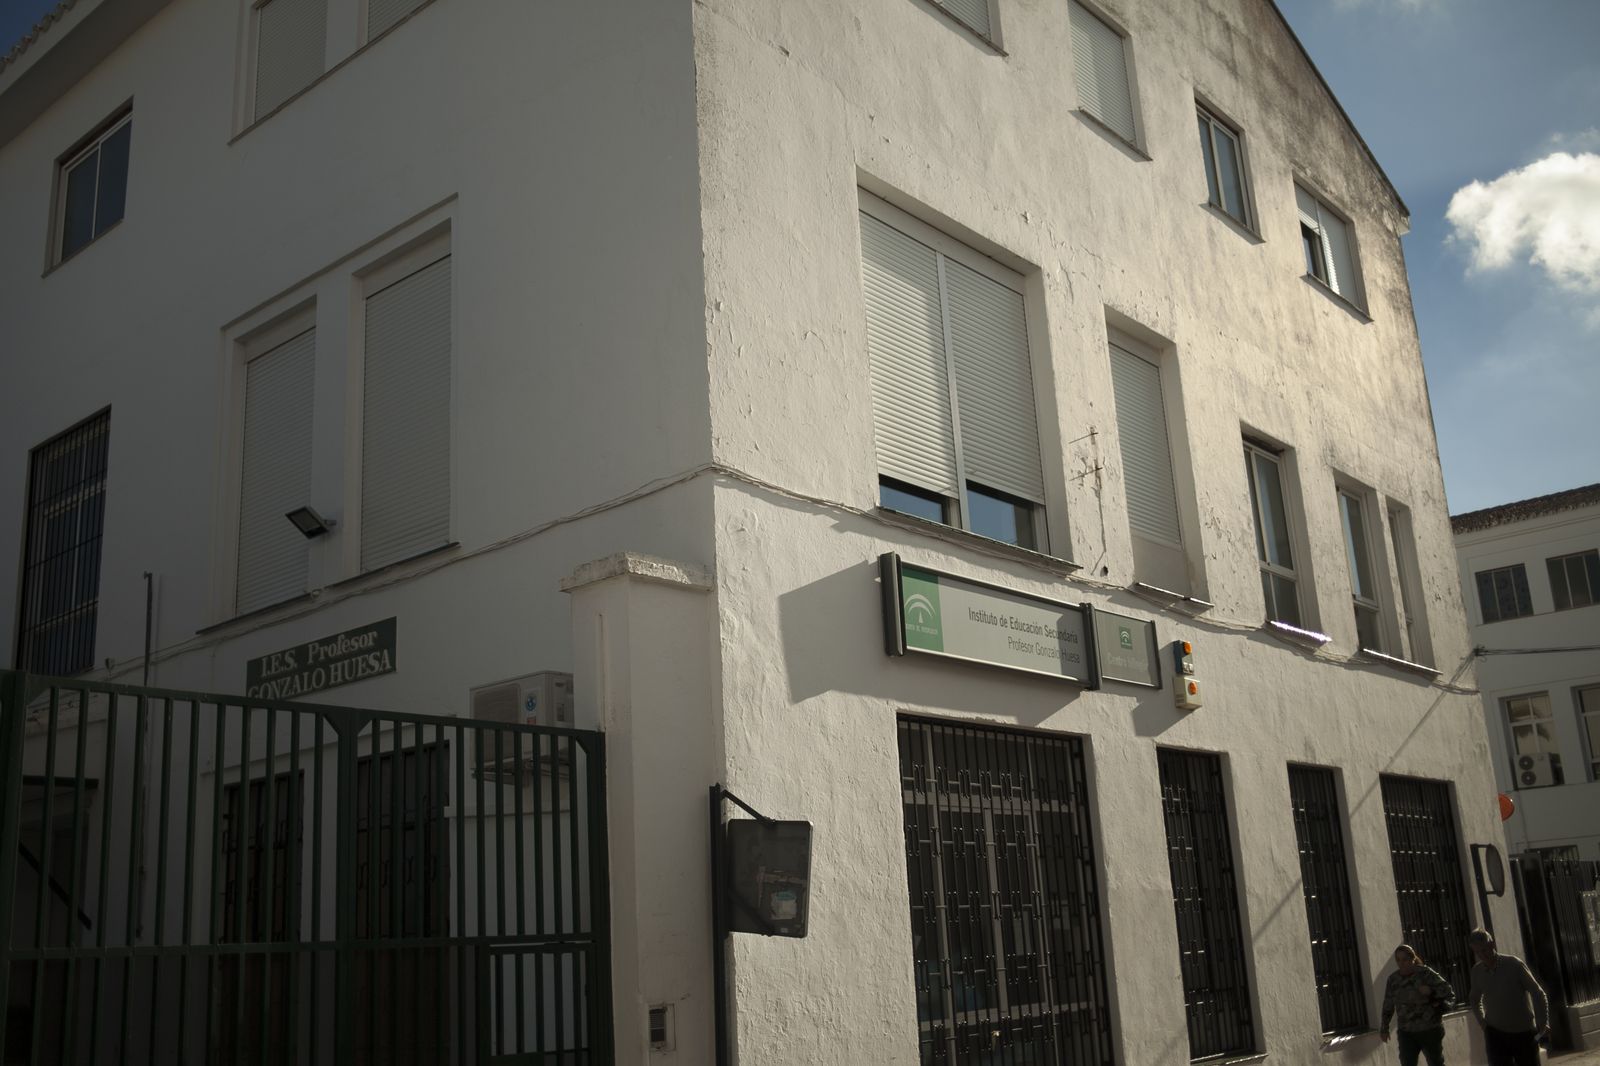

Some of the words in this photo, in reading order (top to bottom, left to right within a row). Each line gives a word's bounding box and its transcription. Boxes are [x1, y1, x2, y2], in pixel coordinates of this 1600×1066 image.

[968, 607, 998, 627] Instituto
[1000, 615, 1008, 628] de
[1010, 616, 1043, 636] Educación
[1044, 624, 1079, 644] Secundaria
[261, 649, 298, 677] I.E.S.
[307, 631, 378, 664] Profesor
[1007, 636, 1034, 654] Profesor
[1035, 642, 1061, 660] Gonzalo
[1061, 648, 1080, 664] Huesa
[248, 668, 325, 699] GONZALO
[329, 648, 392, 685] HUESA
